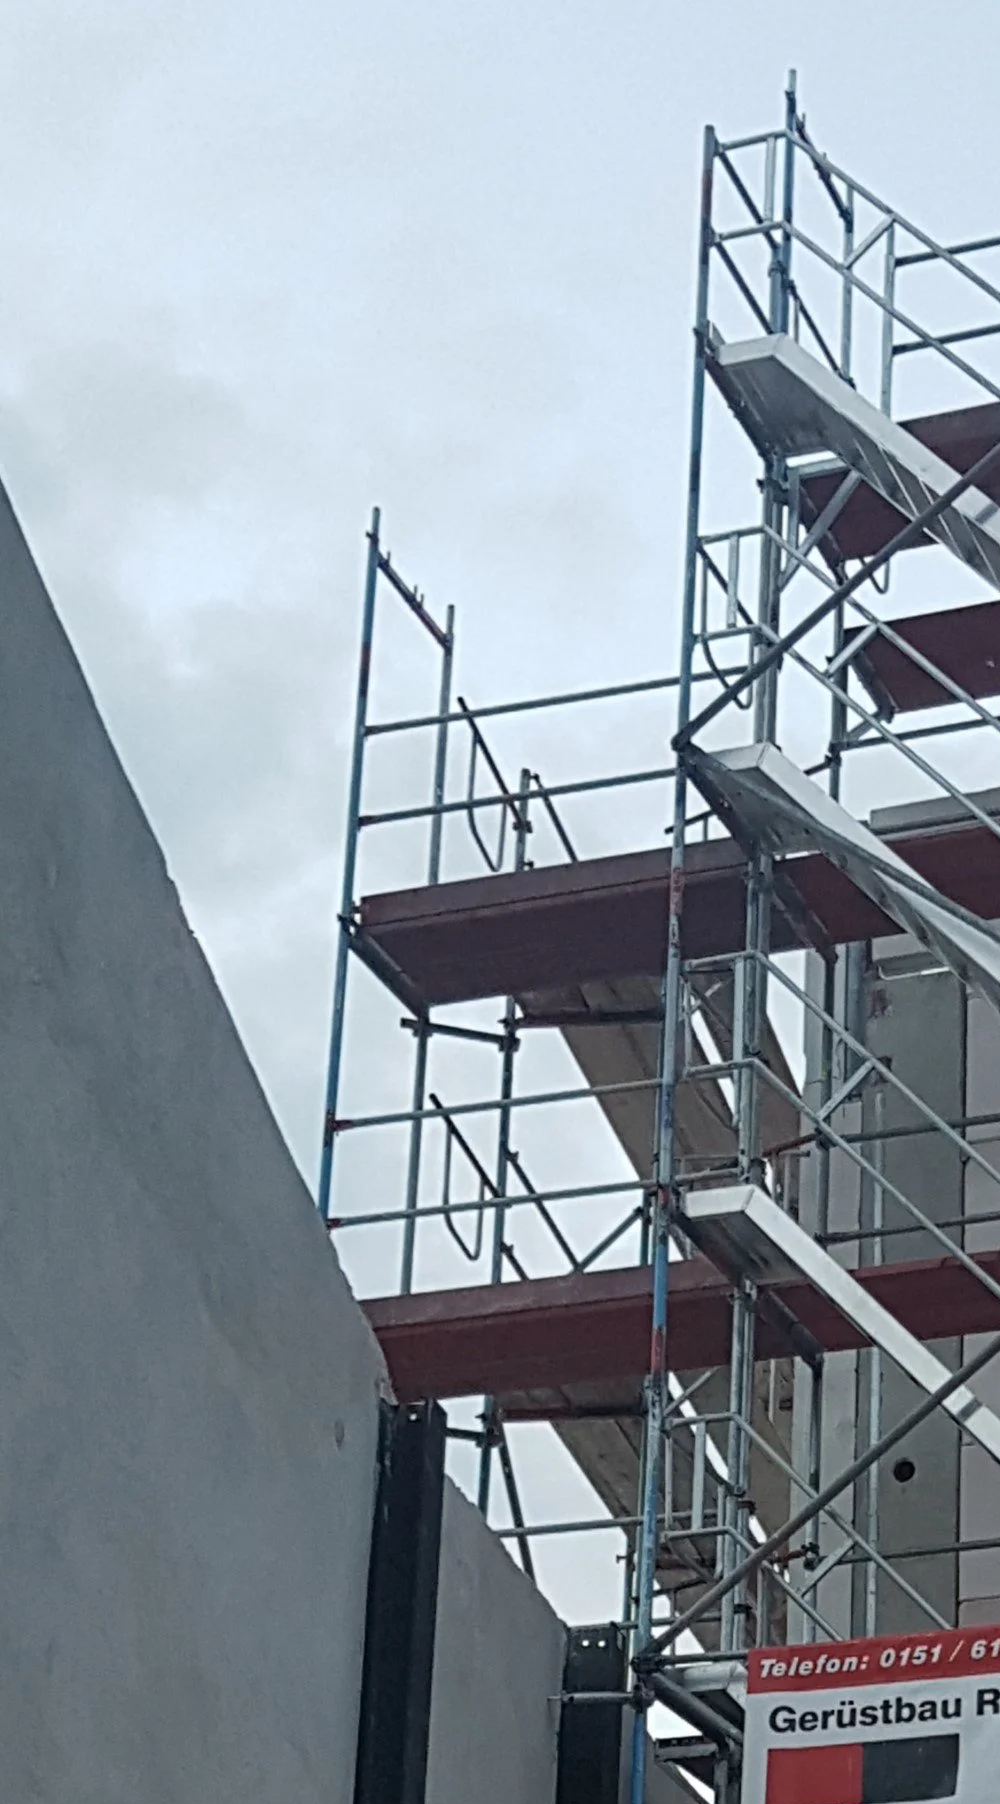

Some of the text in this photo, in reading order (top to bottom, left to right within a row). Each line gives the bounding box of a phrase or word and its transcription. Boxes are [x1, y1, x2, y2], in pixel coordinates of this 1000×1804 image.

[759, 1654, 868, 1678] Telefon:
[879, 1645, 942, 1669] 0151
[949, 1640, 963, 1663] /
[768, 1696, 962, 1733] Gerüstbau
